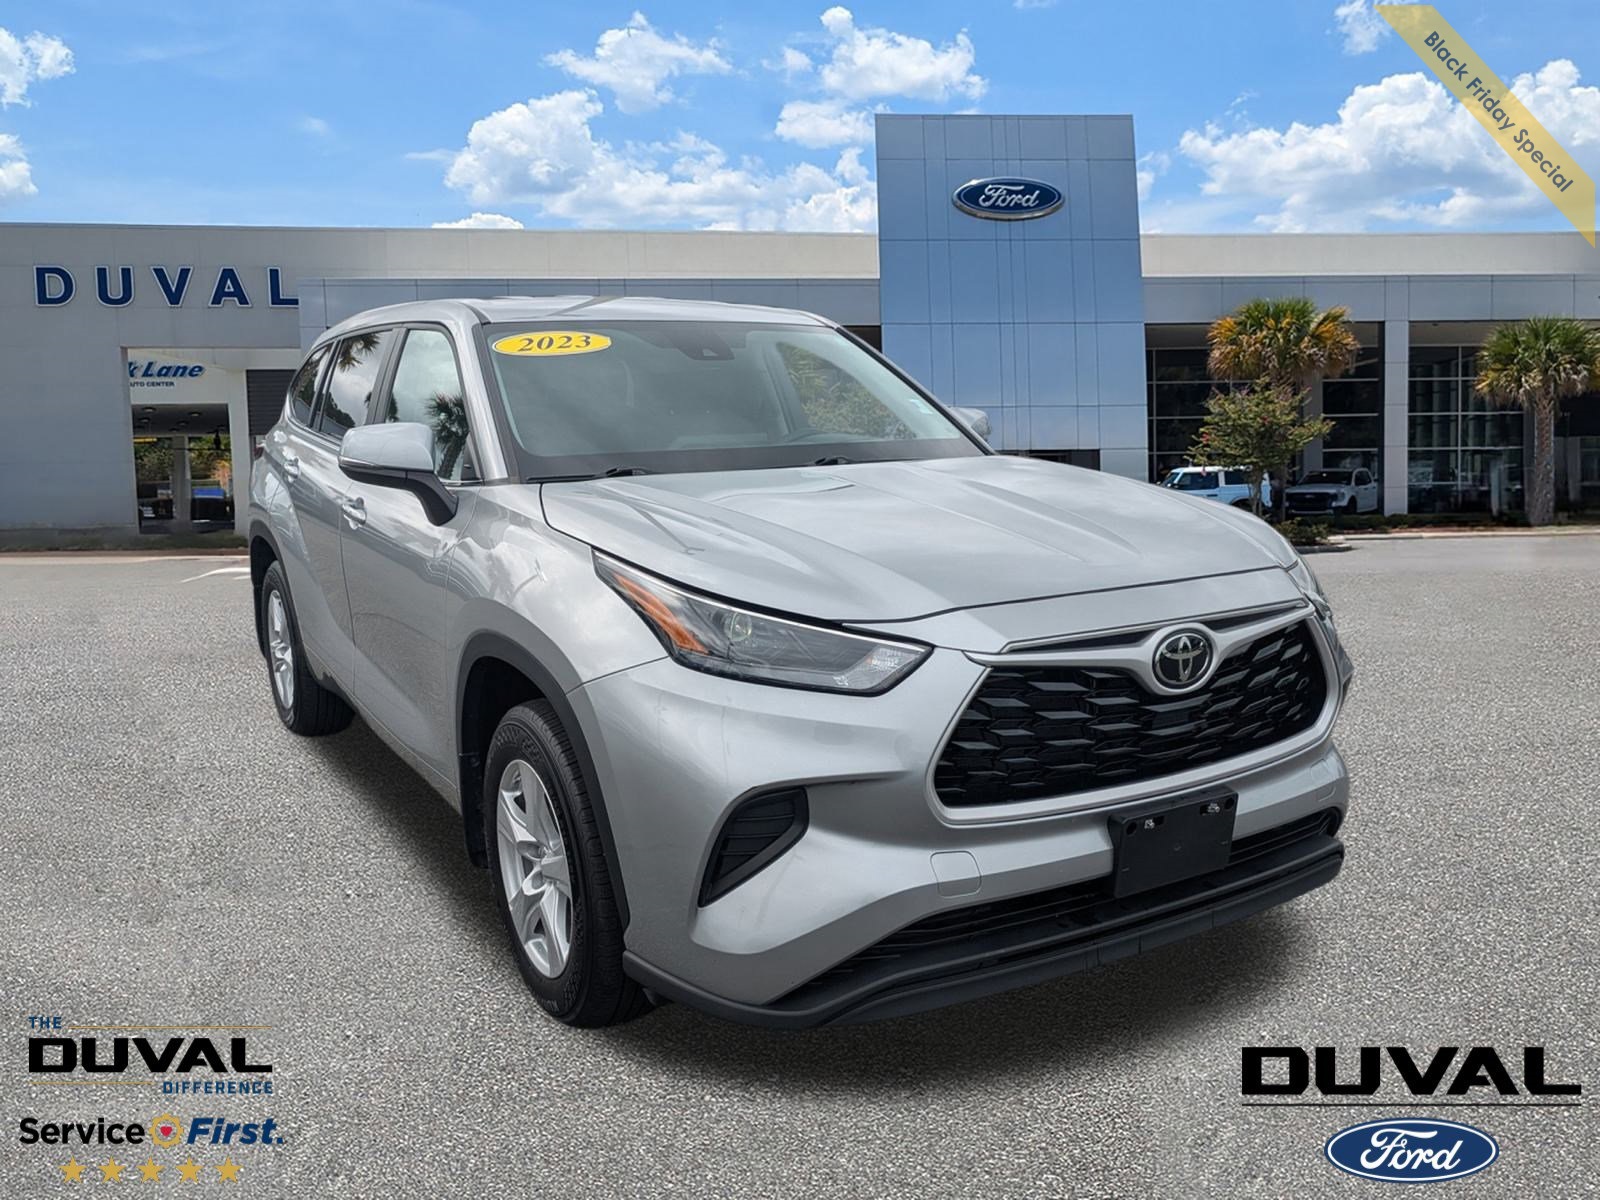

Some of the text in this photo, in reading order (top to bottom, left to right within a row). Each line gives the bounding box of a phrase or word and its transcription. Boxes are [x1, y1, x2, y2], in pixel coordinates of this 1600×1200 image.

[978, 184, 1041, 207] Ford
[33, 264, 299, 307] DUVAL
[517, 335, 591, 352] 2023
[141, 361, 205, 378] Lane
